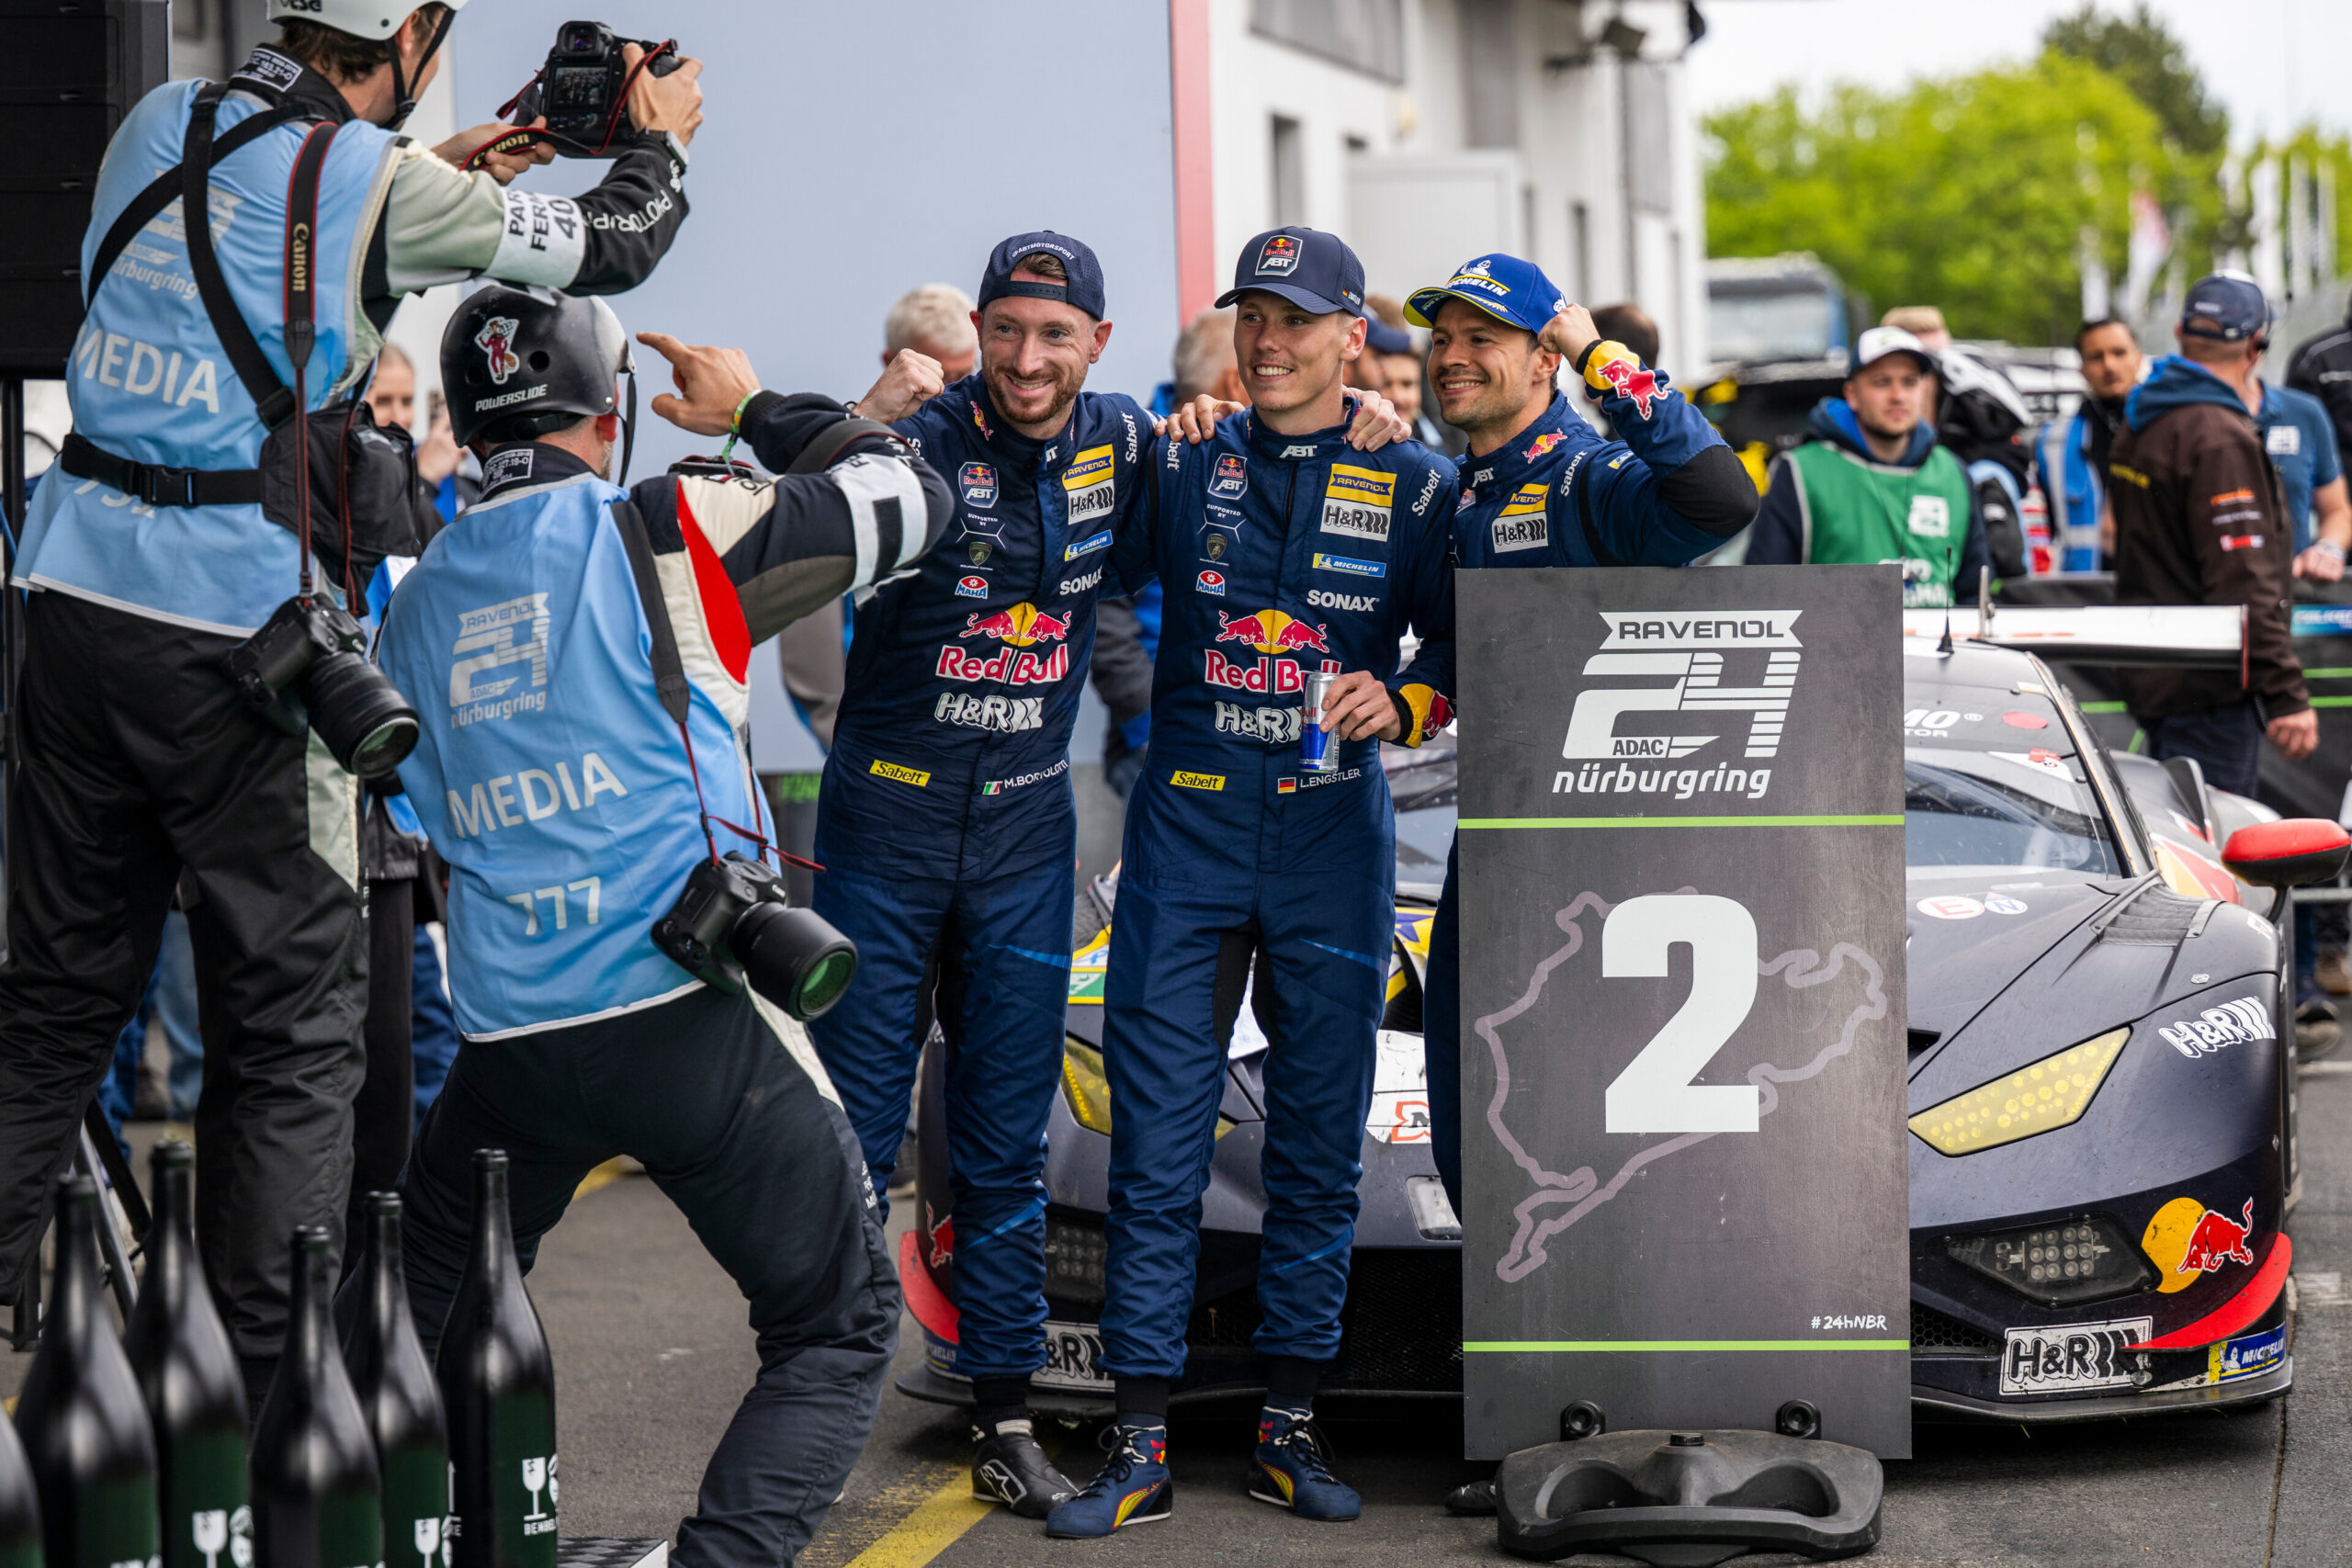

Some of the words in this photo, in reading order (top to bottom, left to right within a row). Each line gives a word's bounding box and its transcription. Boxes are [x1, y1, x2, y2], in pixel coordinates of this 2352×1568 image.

[473, 133, 530, 166] Cnon
[553, 197, 578, 241] 40
[291, 222, 310, 292] Canon
[1012, 242, 1076, 261] @ABTMOTORSPORT
[1261, 257, 1293, 269] ABT
[1265, 247, 1278, 256] Red
[1279, 248, 1295, 257] Bull
[475, 383, 548, 412] POWERSLIDE
[1121, 412, 1138, 464] Sabelt
[1279, 445, 1317, 458] ABT
[963, 475, 979, 485] Red
[979, 476, 994, 486] Bull
[1067, 458, 1109, 477] RAVENOL
[1217, 468, 1231, 477] Red
[1231, 468, 1245, 479] Bull
[1560, 449, 1589, 497] Sabelt
[966, 487, 993, 500] ABT
[1215, 479, 1243, 491] ABT
[1337, 477, 1386, 492] RAVENOL
[1411, 468, 1442, 517] Sabelt
[1069, 490, 1102, 517] H&R
[1206, 503, 1241, 516] SUPPORTED
[1324, 504, 1366, 532] H&R
[1079, 536, 1108, 552] MICHELIN
[1494, 521, 1531, 547] H&R
[1332, 560, 1380, 572] MICHELIN
[956, 585, 988, 598] MAHA
[1059, 566, 1102, 596] SONAX
[1197, 579, 1225, 595] MAHA
[1306, 589, 1378, 612] SONAX
[466, 601, 539, 629] RAVENOL
[1619, 620, 1785, 640] RAVENOL
[935, 644, 1012, 683] Red
[1010, 643, 1069, 686] Bull
[1204, 649, 1270, 694] Red
[450, 690, 548, 729] nürburgring
[934, 692, 1014, 733] H&R
[1562, 651, 1802, 760] 24
[1215, 701, 1293, 743] H&R
[1611, 738, 1665, 757] ADAC
[876, 761, 925, 784] Sabelt
[1176, 772, 1219, 789] Sabelt
[1299, 768, 1362, 788] L.ENGSTLER
[1551, 761, 1772, 801] nürburgring
[446, 751, 628, 839] MEDIA
[506, 874, 601, 936] 777
[1601, 893, 1760, 1134] 2
[2008, 1334, 2099, 1382] H&R
